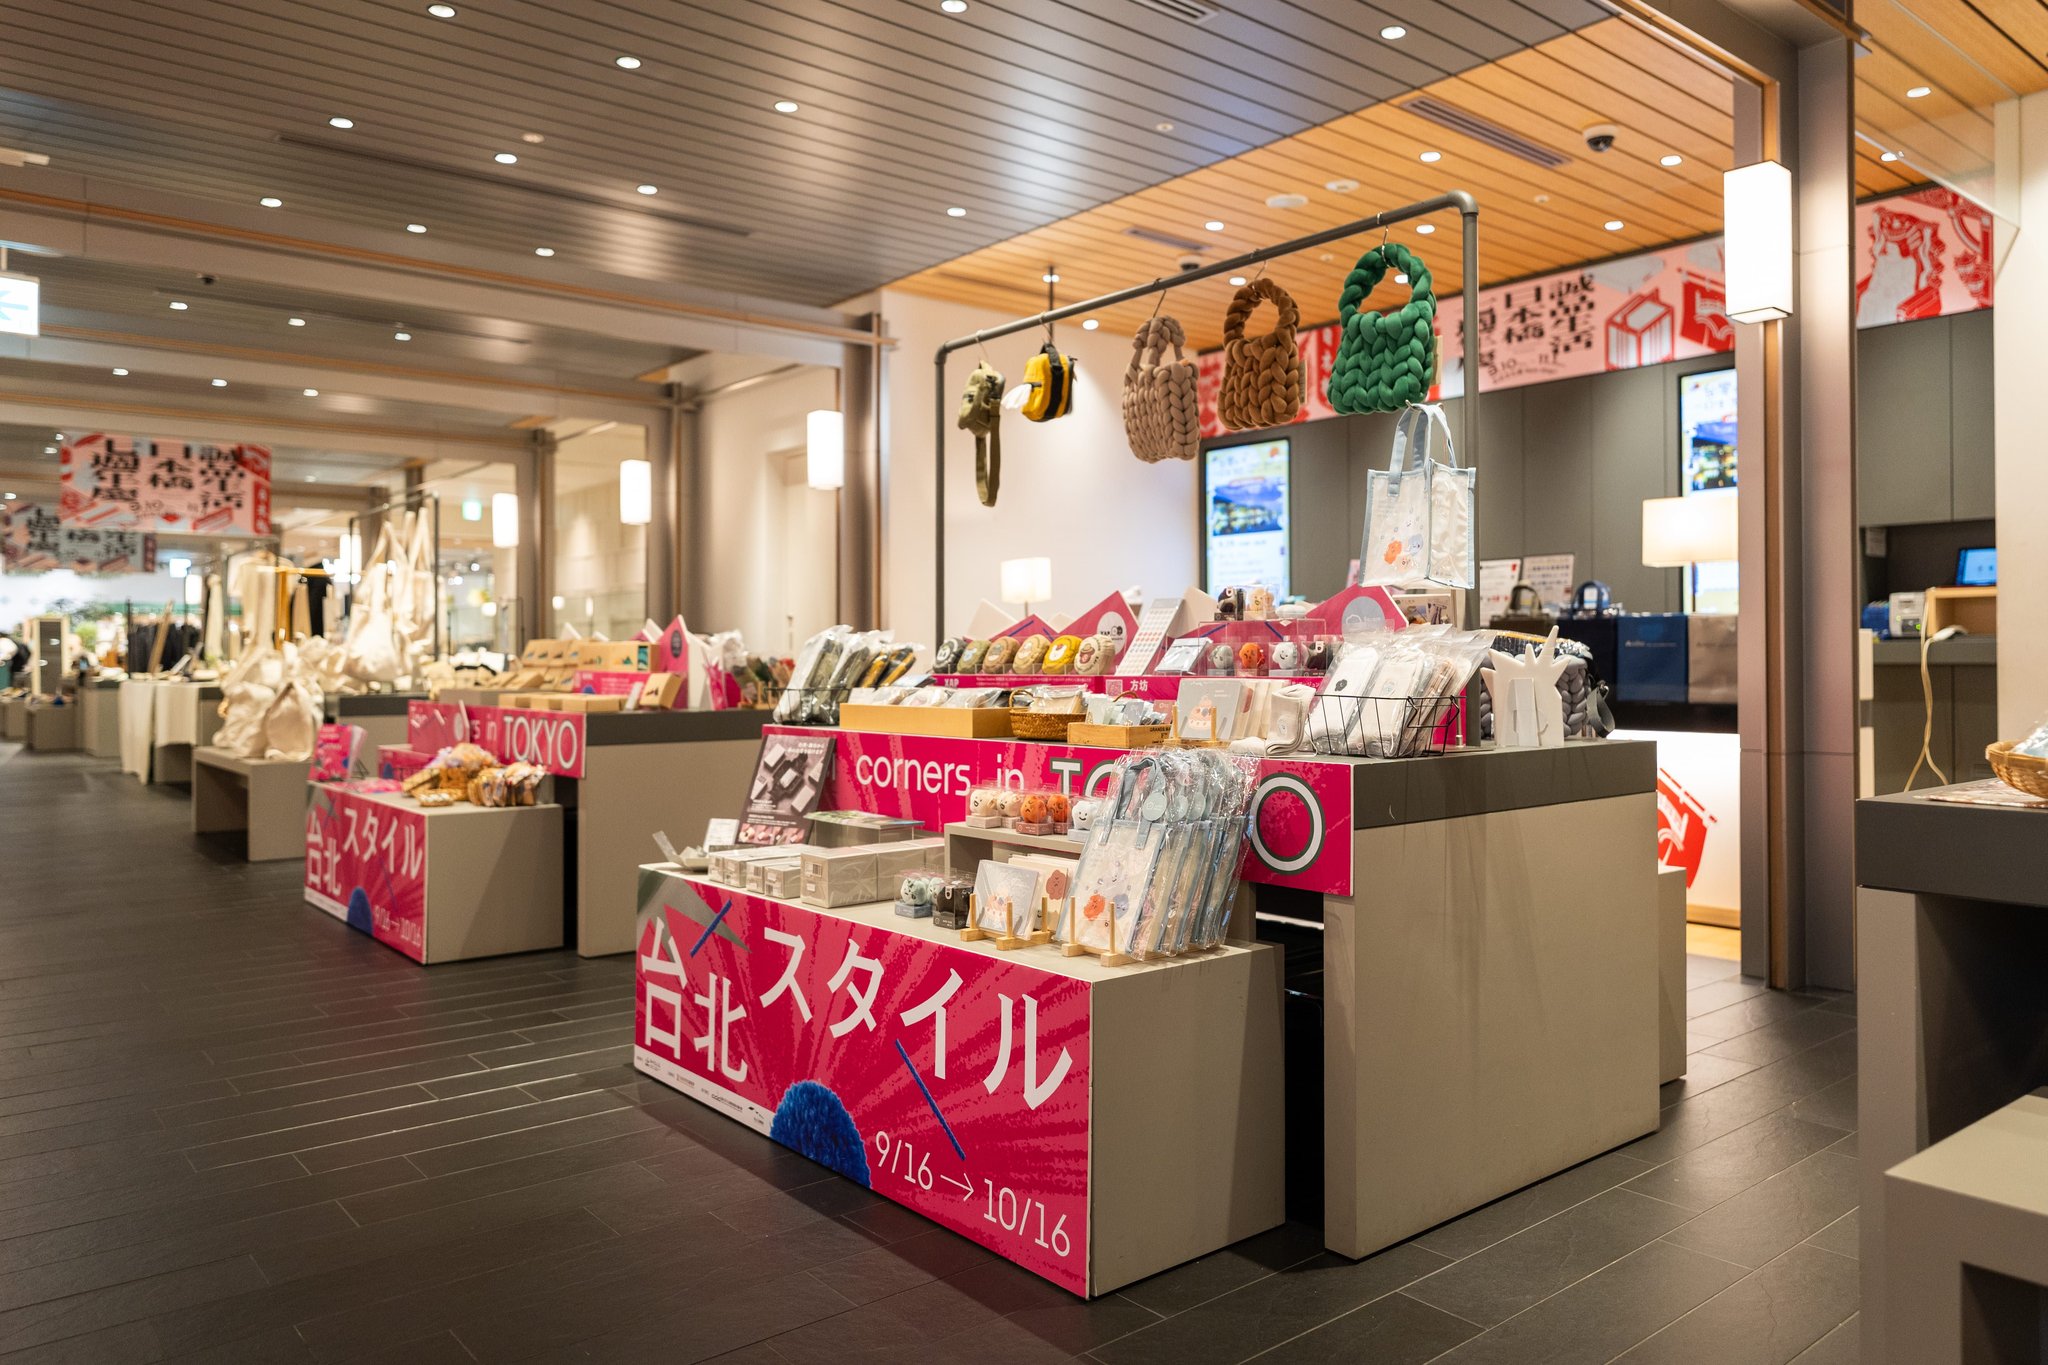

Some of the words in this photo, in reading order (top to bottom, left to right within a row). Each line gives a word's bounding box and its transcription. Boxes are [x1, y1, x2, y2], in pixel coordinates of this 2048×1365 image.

[486, 715, 498, 742] in
[503, 714, 578, 770] TOKYO
[855, 754, 972, 797] corners
[996, 754, 1025, 794] in
[875, 1130, 934, 1192] 9/16
[983, 1178, 1072, 1258] 10/16
